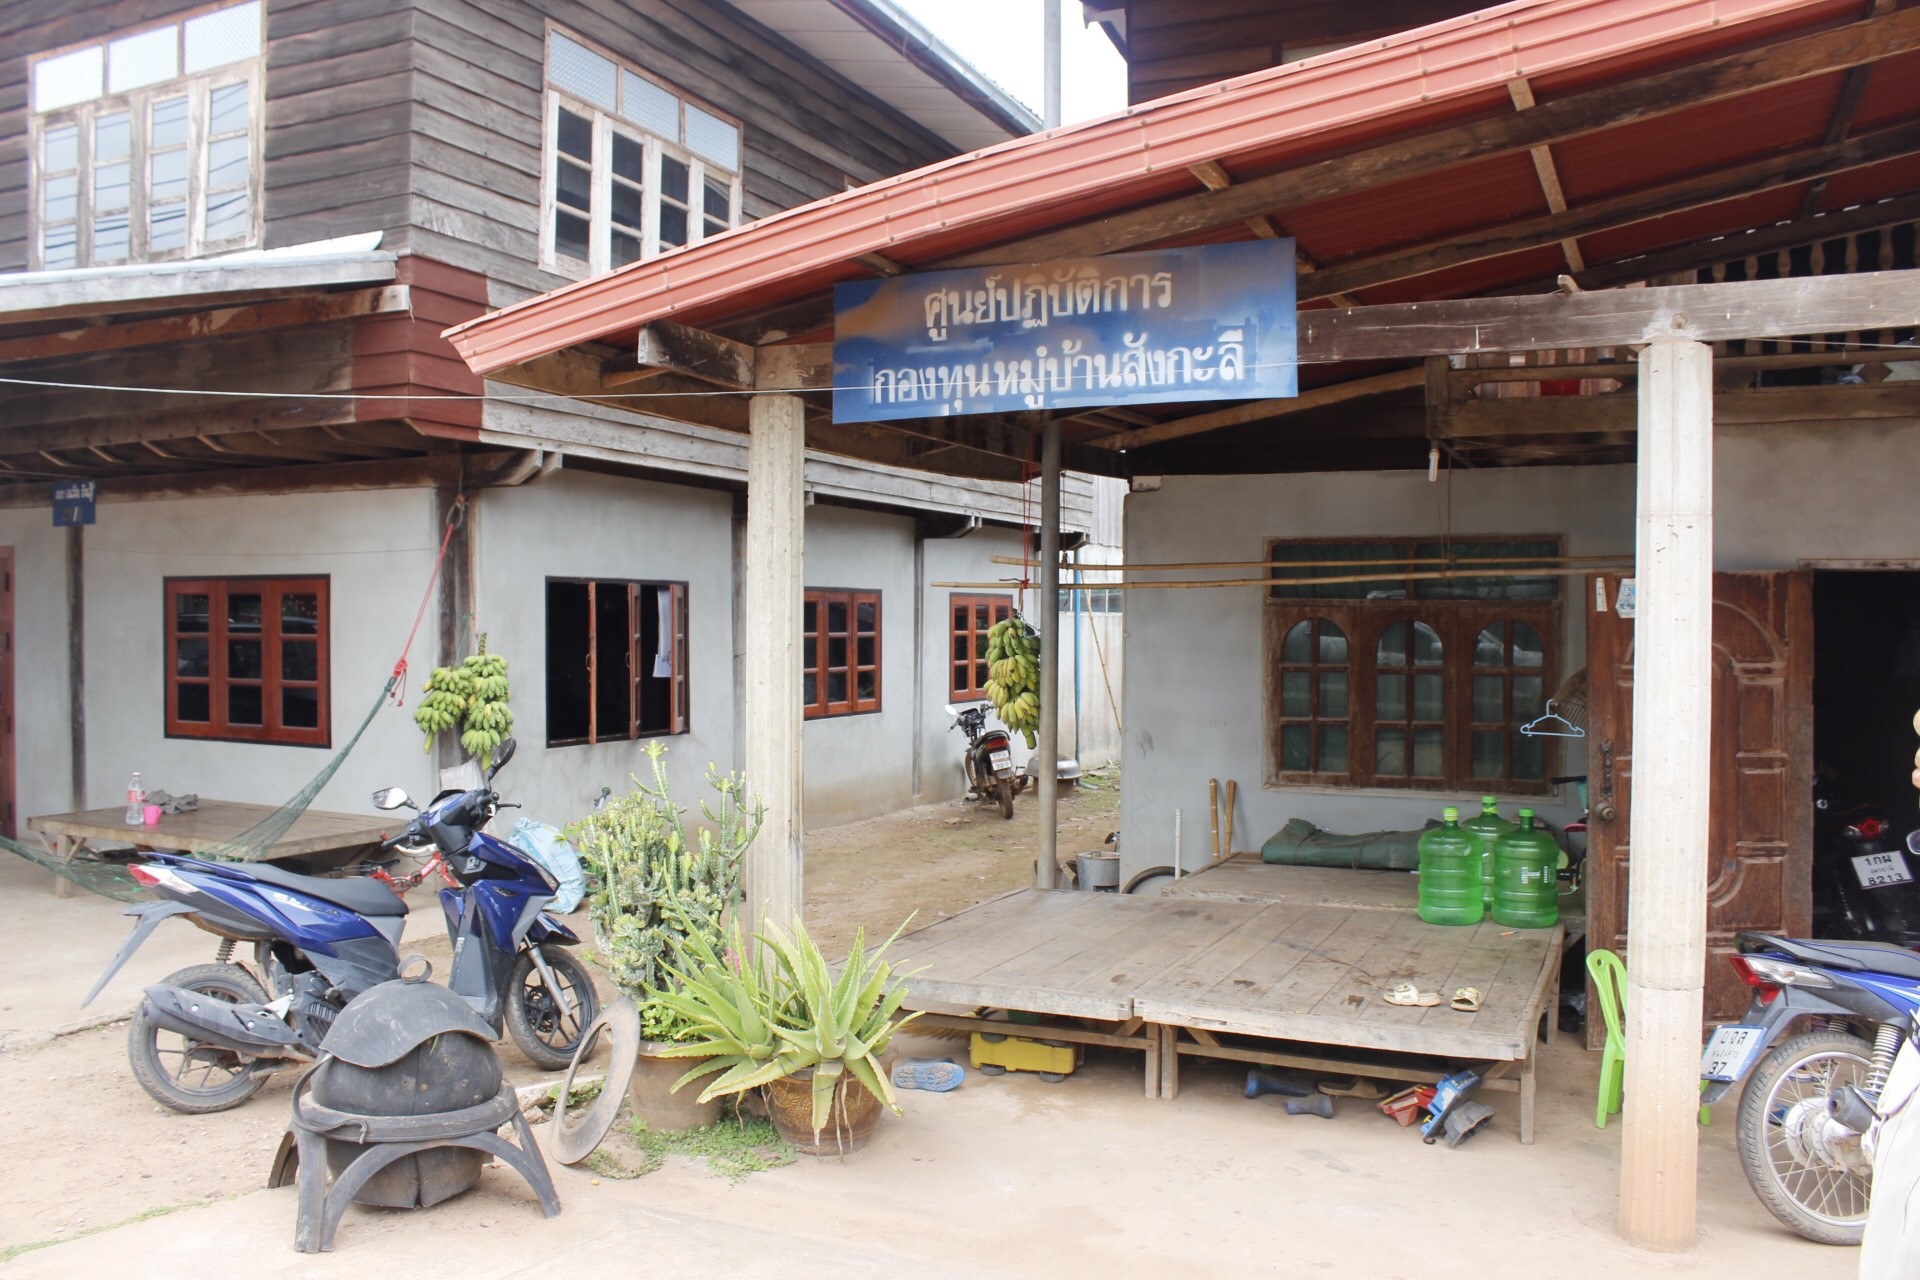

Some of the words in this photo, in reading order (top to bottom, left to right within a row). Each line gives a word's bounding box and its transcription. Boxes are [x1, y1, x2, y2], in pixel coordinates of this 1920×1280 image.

[924, 264, 1173, 342] ศูนย์ปฏิบัติการ
[1868, 872, 1905, 886] 8213
[1707, 1061, 1729, 1075] 37
